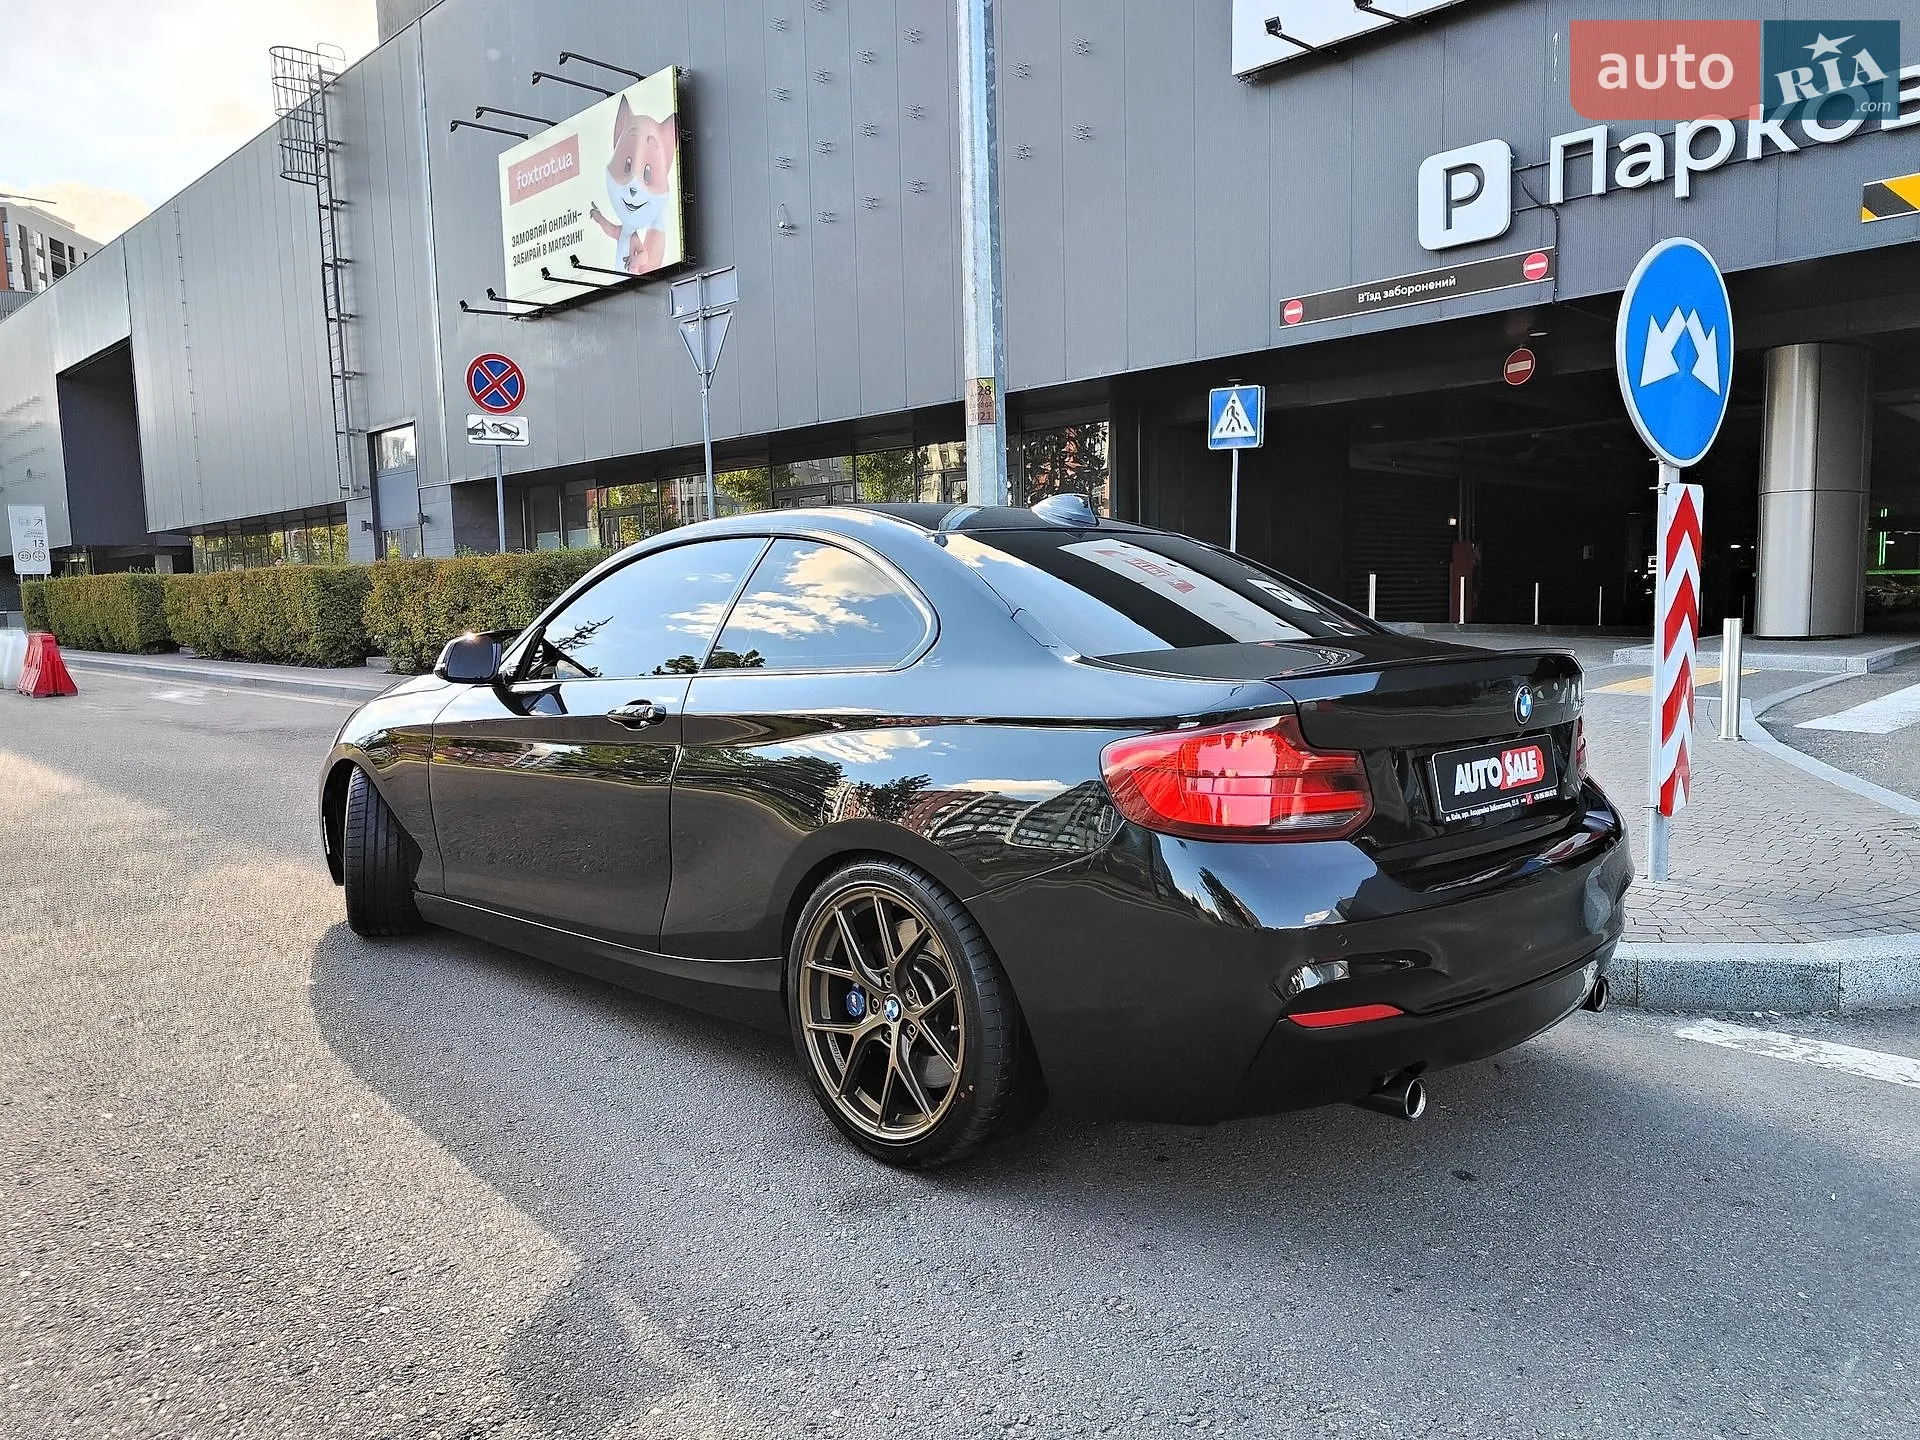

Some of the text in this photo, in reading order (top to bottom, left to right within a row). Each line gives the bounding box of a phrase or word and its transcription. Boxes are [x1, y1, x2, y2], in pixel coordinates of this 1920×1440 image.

[516, 152, 573, 189] foxtrot.ua
[511, 219, 548, 247] ЗАМОВЛЯЙ
[512, 242, 541, 267] ЗАБИРАЙ
[542, 243, 548, 255] В
[1383, 275, 1456, 297] заборонений
[1454, 757, 1503, 796] AUTO
